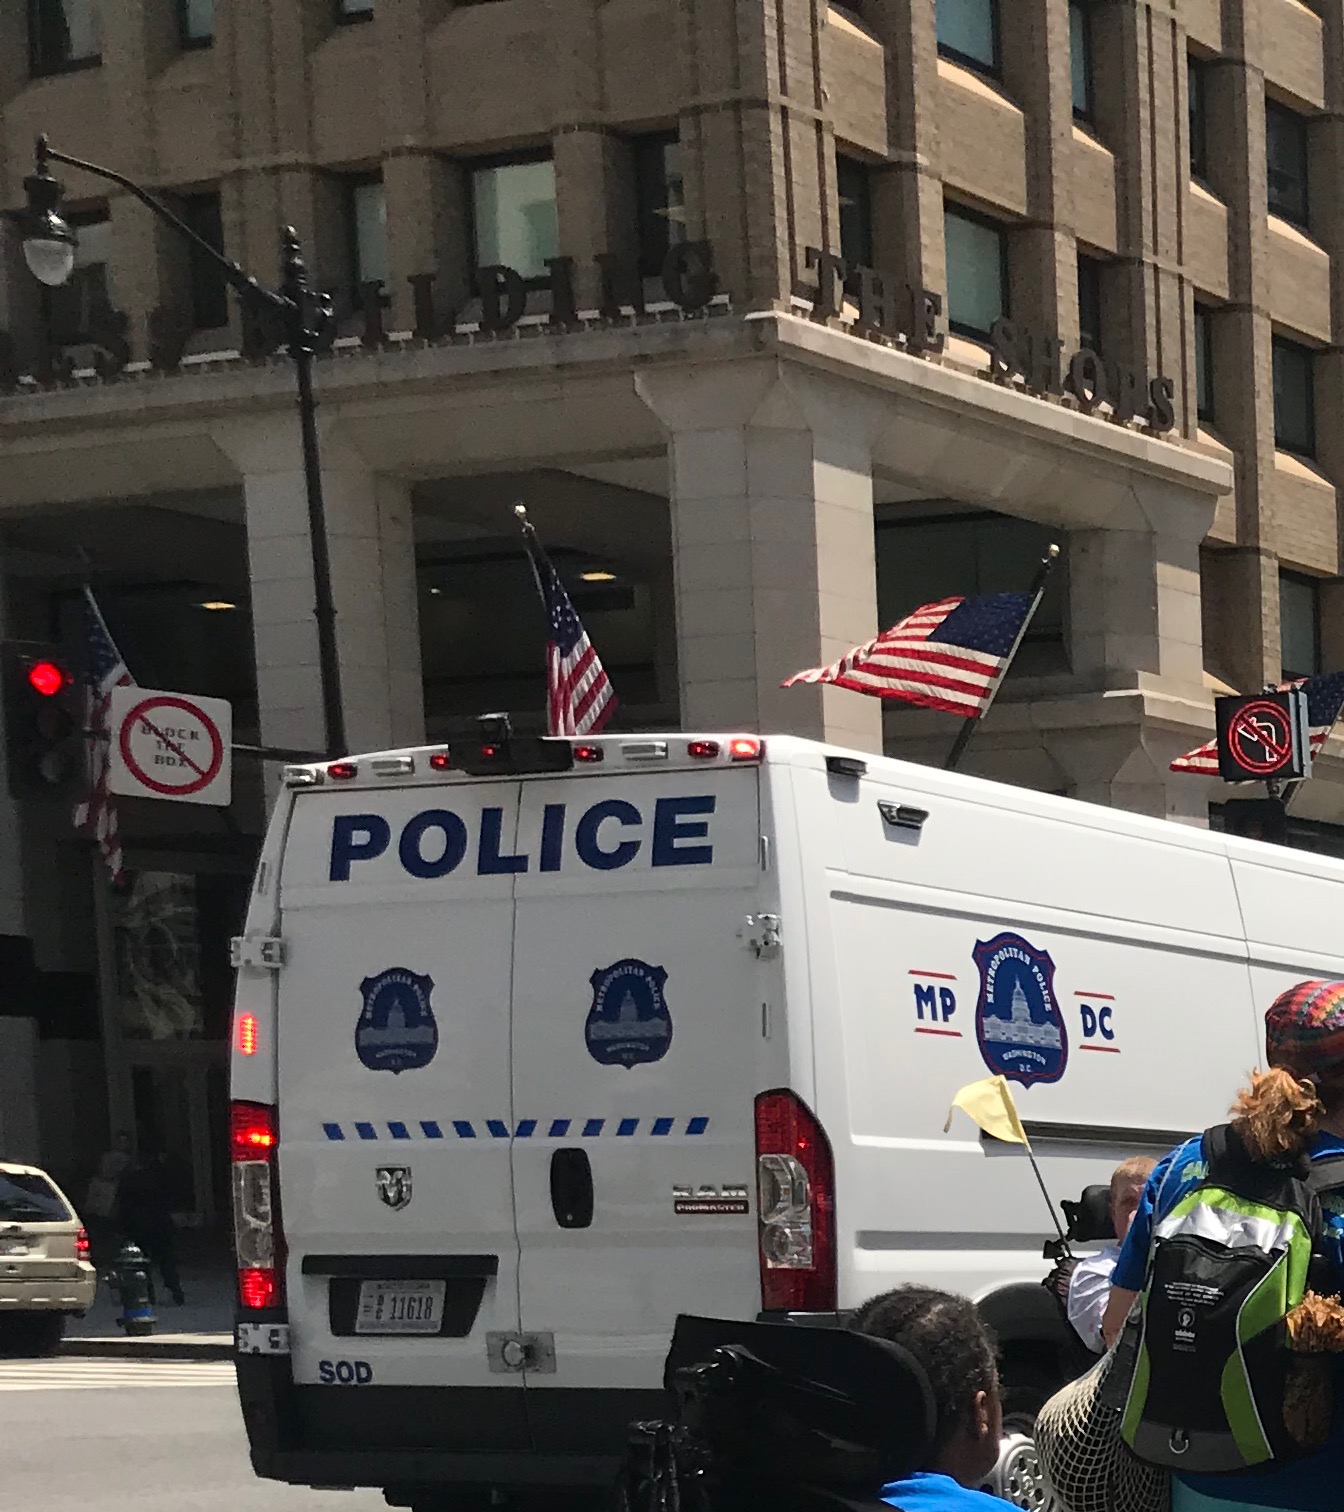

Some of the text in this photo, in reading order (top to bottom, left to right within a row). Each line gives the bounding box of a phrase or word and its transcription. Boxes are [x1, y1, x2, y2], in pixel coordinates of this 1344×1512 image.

[804, 245, 1175, 431] THE SHOPS
[329, 795, 717, 882] POLICE
[986, 946, 1052, 1012] METROPOLITAN POLICE
[913, 983, 957, 1023] MP
[1079, 1003, 1115, 1040] DC
[389, 1295, 434, 1320] 11618
[318, 1360, 374, 1384] SOD
